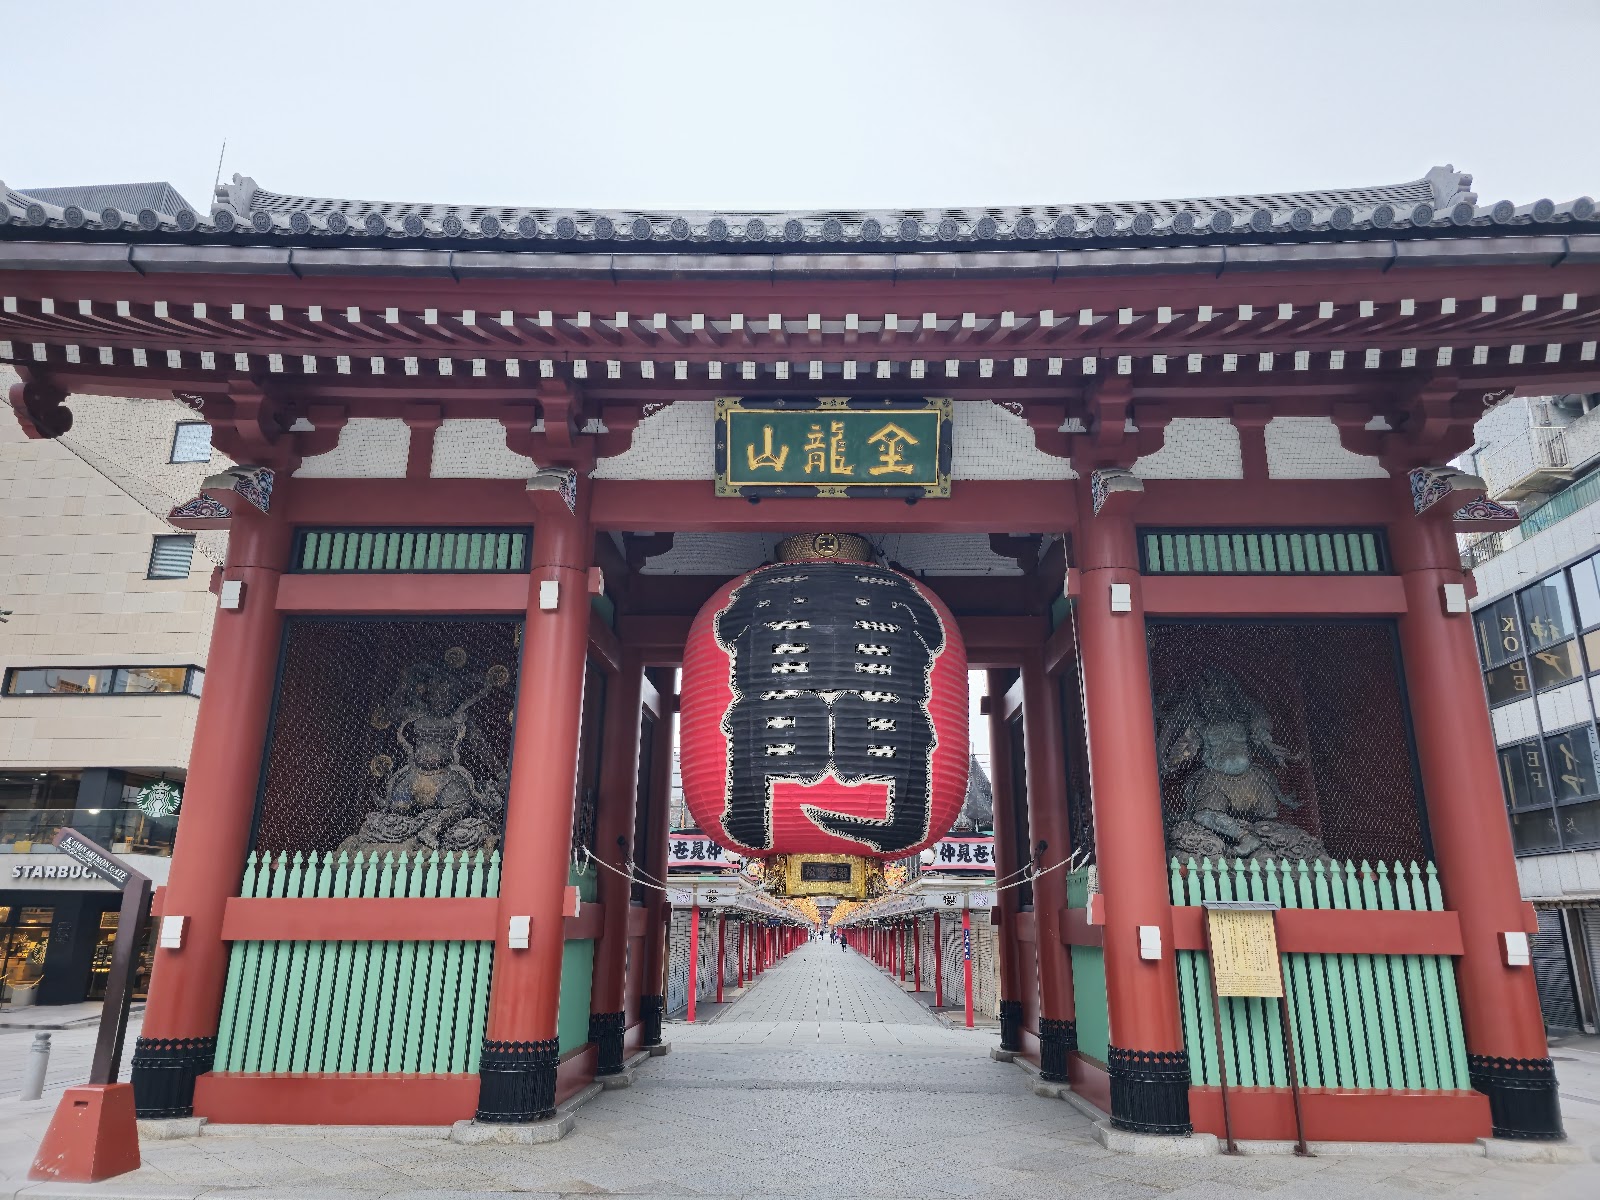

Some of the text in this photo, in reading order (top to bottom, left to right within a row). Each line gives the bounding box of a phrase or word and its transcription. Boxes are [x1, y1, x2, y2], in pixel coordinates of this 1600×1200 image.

[713, 561, 947, 854] 雷門
[66, 836, 112, 868] KAMINARIMON
[940, 842, 996, 863] 仲見世
